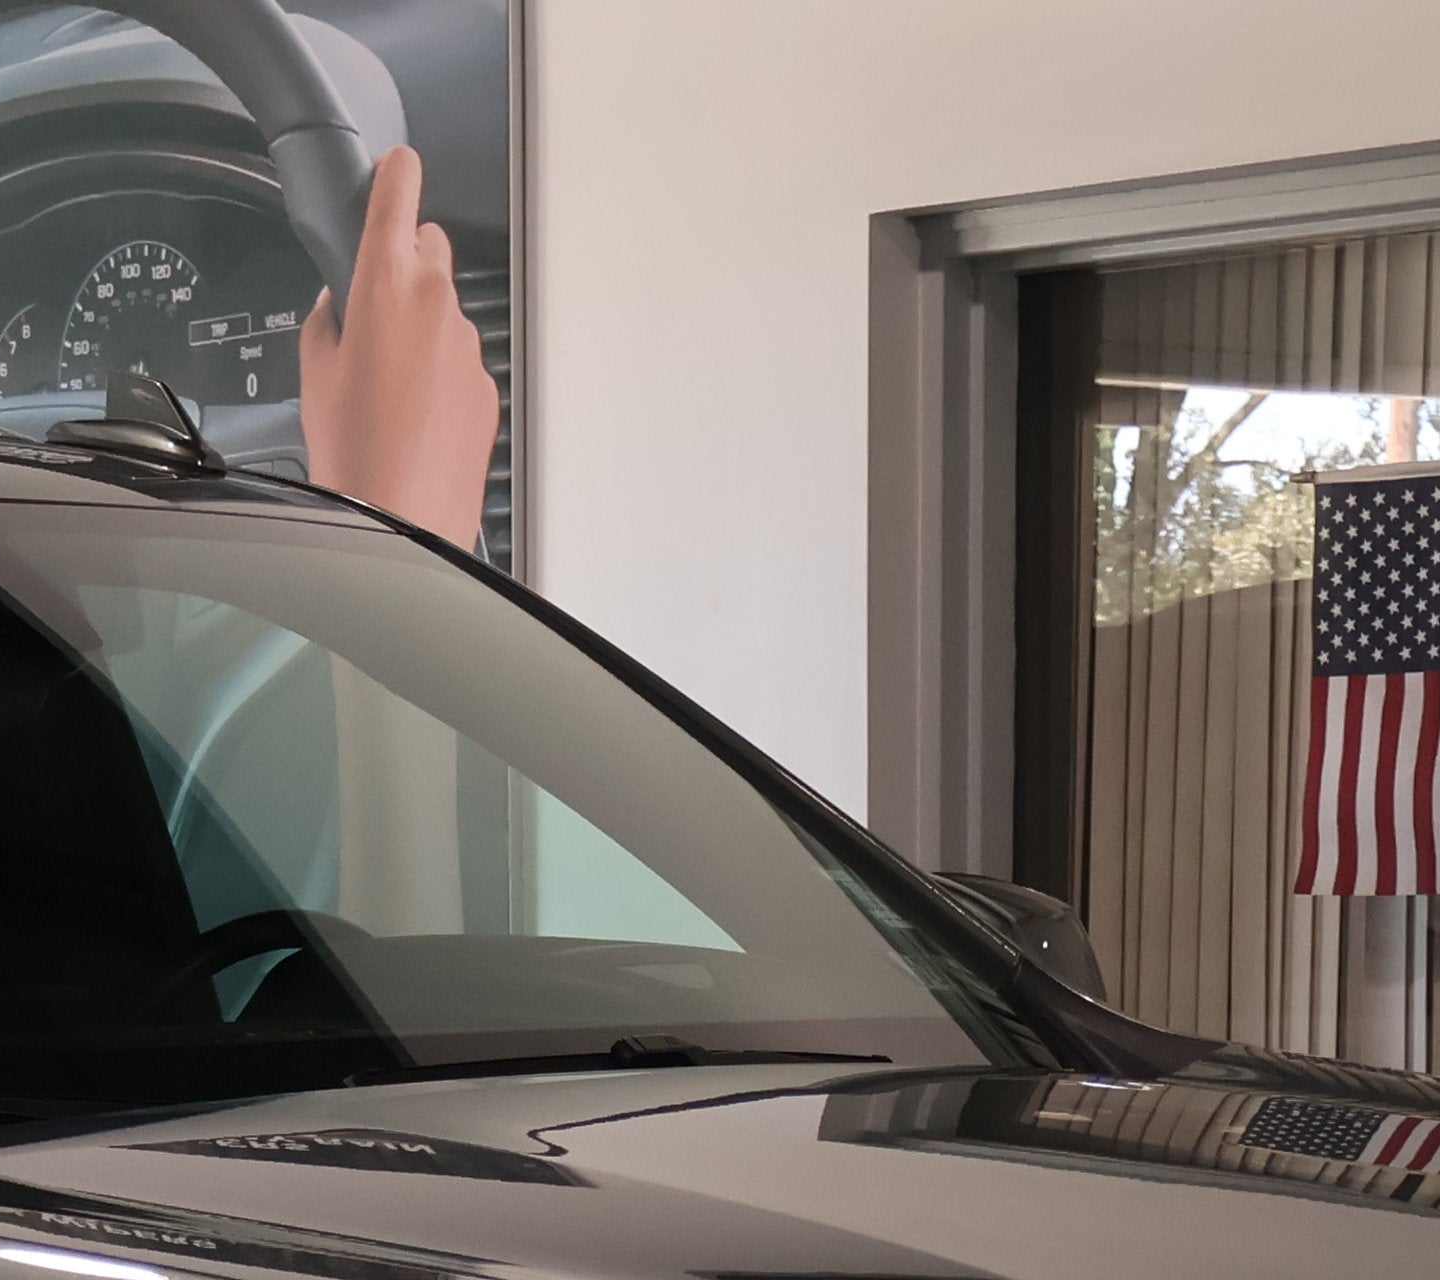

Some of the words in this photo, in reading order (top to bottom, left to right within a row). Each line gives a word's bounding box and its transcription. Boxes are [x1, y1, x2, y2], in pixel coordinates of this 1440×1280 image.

[120, 263, 141, 279] 100
[151, 264, 172, 280] 120
[97, 283, 114, 299] 80
[171, 287, 192, 304] 140
[9, 341, 17, 355] 7
[73, 340, 90, 355] 60
[246, 373, 258, 398] 0
